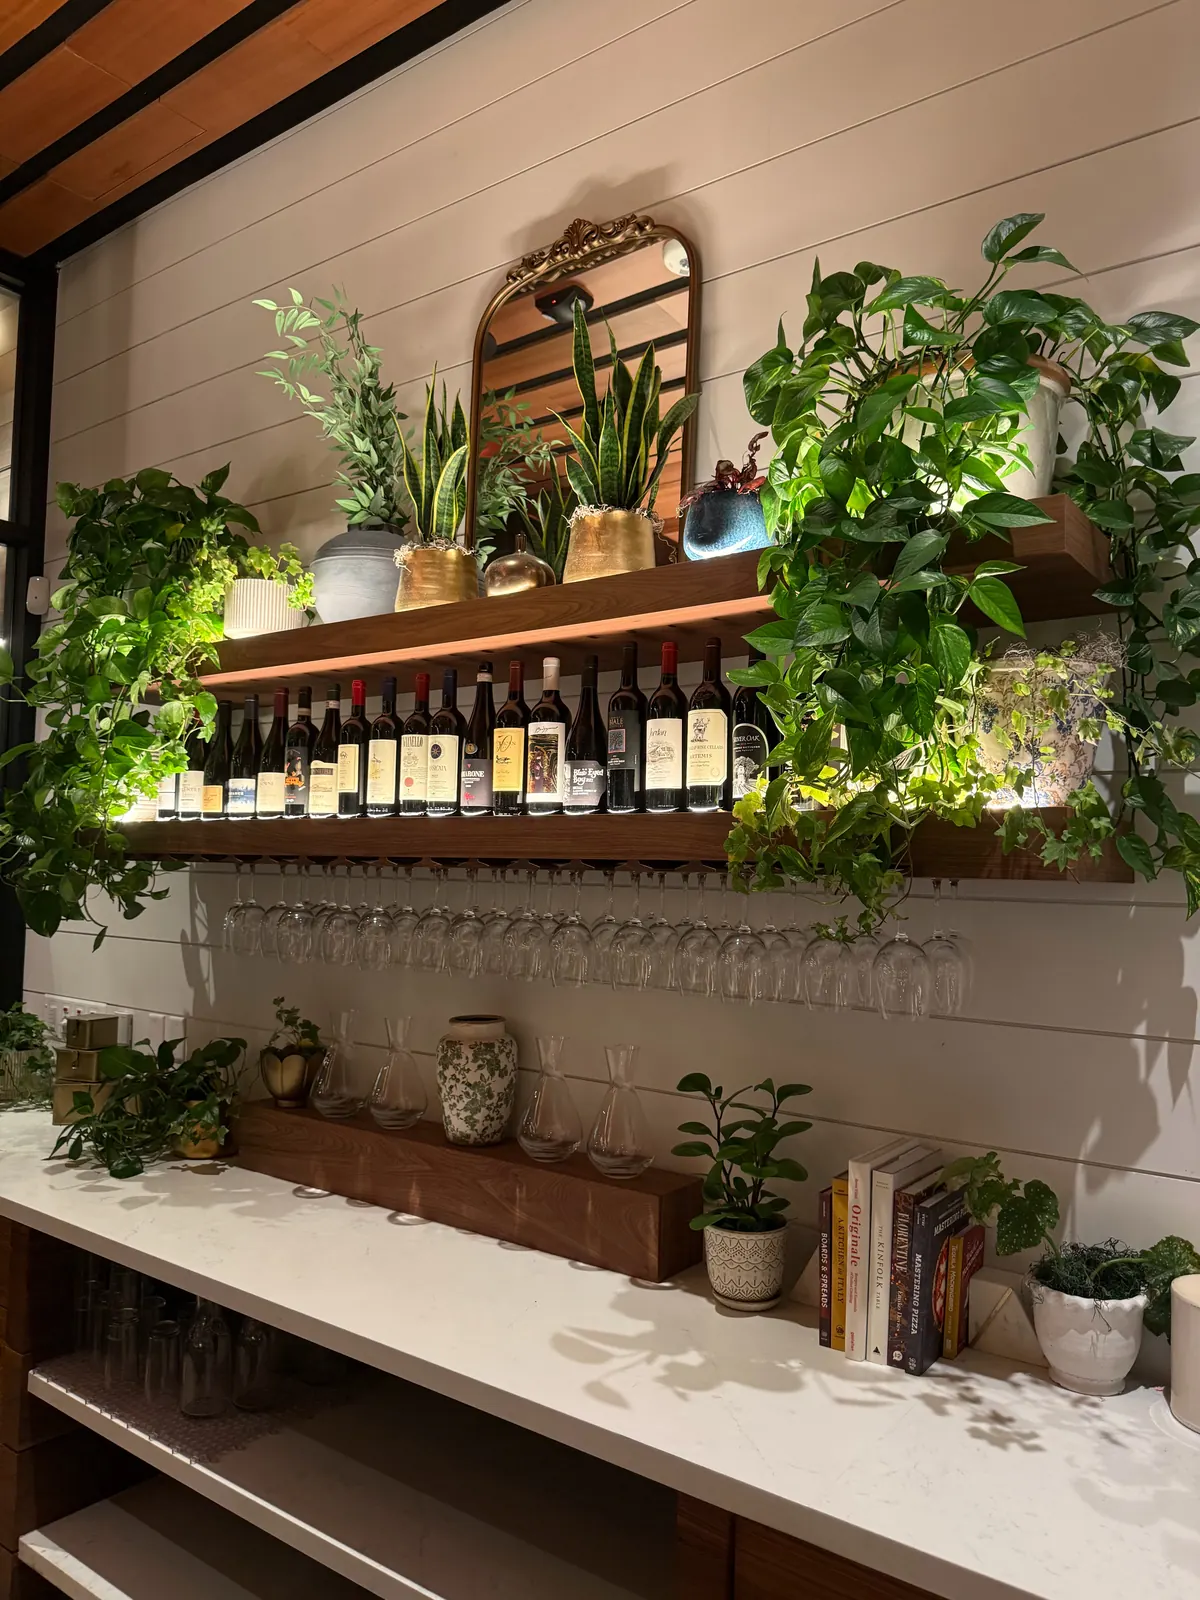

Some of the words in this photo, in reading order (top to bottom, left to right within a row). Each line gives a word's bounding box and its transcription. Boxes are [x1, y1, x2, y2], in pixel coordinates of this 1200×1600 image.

[820, 1232, 828, 1264] BOARDS
[836, 1225, 845, 1267] KITCHEN
[850, 1204, 862, 1268] Originale
[895, 1211, 910, 1273] FLORENTINE
[875, 1241, 885, 1289] KINFOLK
[912, 1253, 923, 1307] MASTERING
[820, 1273, 828, 1308] SPREADS
[836, 1275, 845, 1304] ITALY
[910, 1308, 919, 1335] PIZZA
